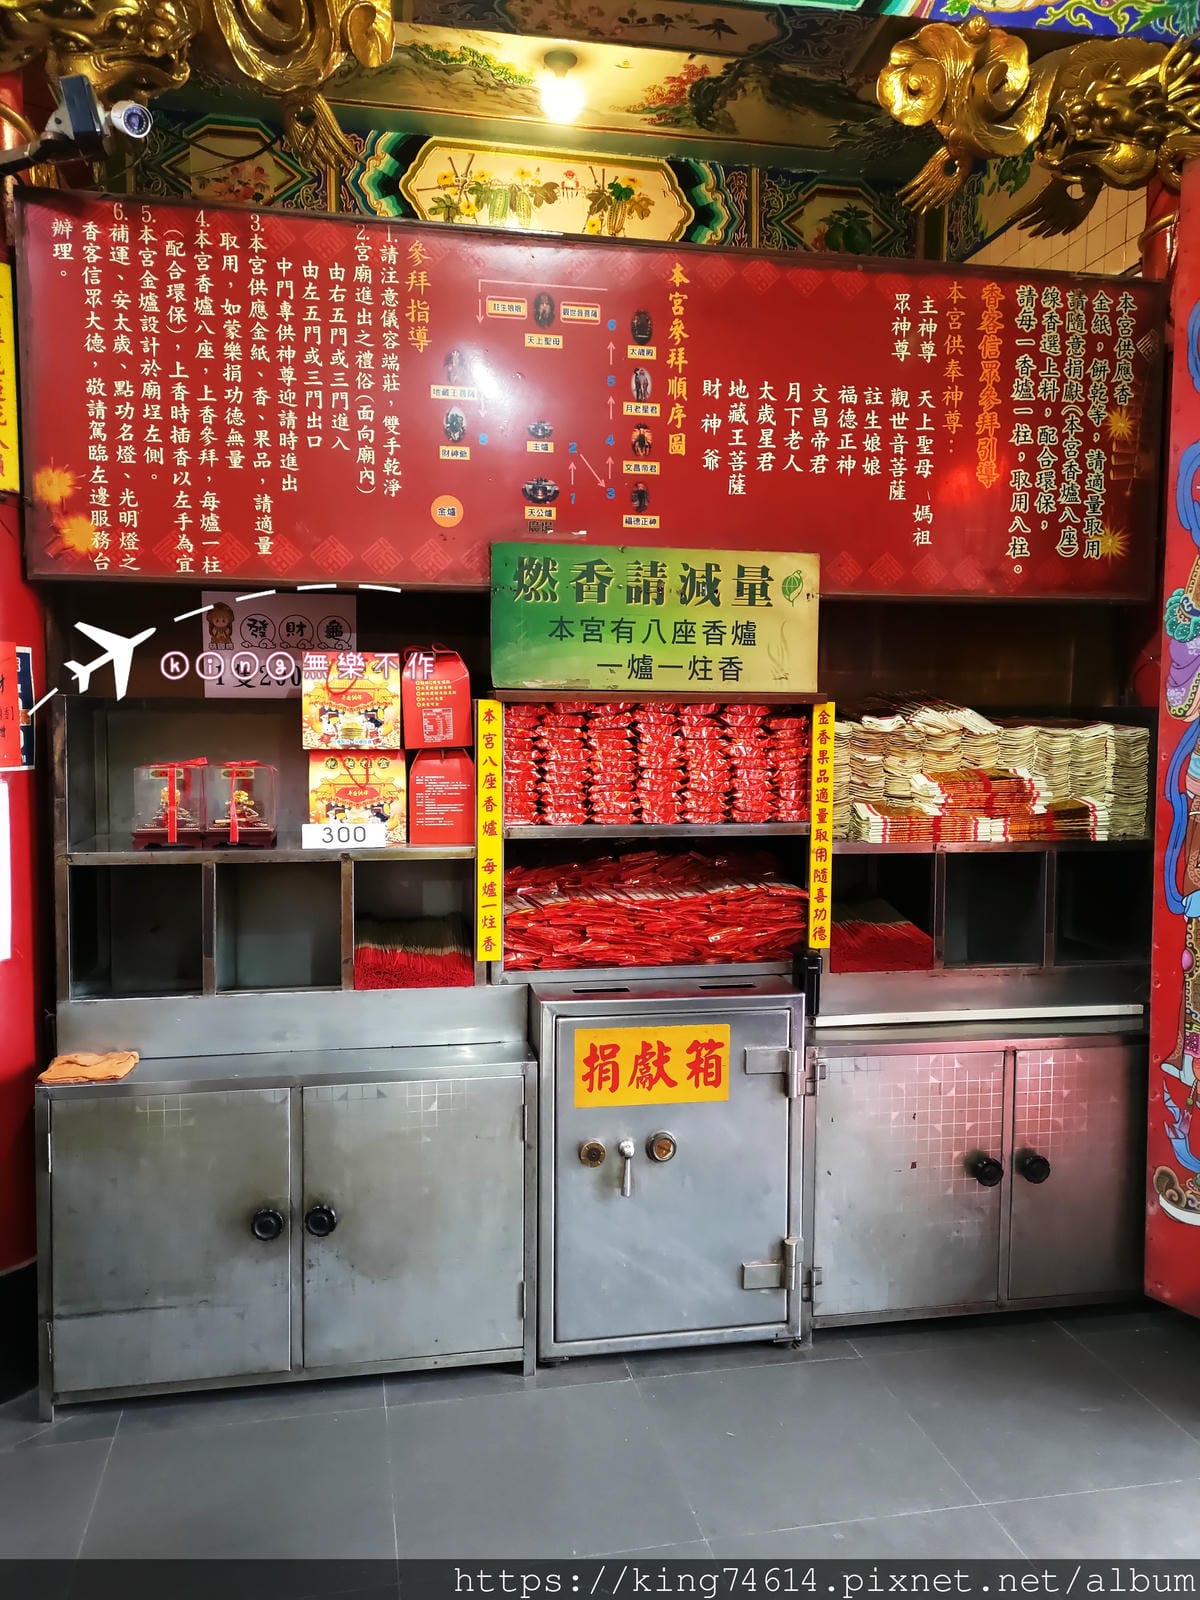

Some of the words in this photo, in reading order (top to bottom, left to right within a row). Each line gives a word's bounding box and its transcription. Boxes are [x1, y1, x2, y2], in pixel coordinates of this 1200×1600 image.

[405, 240, 432, 353] 參拜指導
[891, 293, 911, 363] 眾神尊
[917, 296, 938, 364] 主神尊
[275, 257, 300, 492] 中門專供神尊迎請時進出
[302, 260, 323, 448] 由左五門或三門出口
[328, 262, 350, 451] 由右五門或三門進入
[666, 262, 690, 457] 本宮參拜順序圖
[976, 282, 1005, 488] 香客信眾參拜引導
[1111, 291, 1138, 406] 本宮供應香
[568, 441, 578, 454] 2
[701, 377, 722, 471] 財神爺
[727, 378, 750, 496] 地藏王菩薩
[755, 380, 778, 473] 太歲星君
[782, 381, 804, 473] 月下老人
[809, 383, 831, 475] 文昌帝君
[836, 385, 859, 477] 福德正神
[862, 386, 884, 477] 註生娘娘
[889, 388, 911, 501] 觀世音菩薩
[513, 555, 775, 608] 燃香請減量
[246, 617, 344, 640] 發財龜
[548, 616, 758, 648] 本宮有八座香爐
[596, 653, 745, 683] 一爐一炷香
[481, 707, 498, 837] 本宮八座香爐
[321, 825, 366, 844] 300
[812, 709, 831, 942] 金香果品適量取用隨喜功德
[481, 857, 498, 954] 每爐一炷香
[581, 1038, 726, 1094] 捐獻箱
